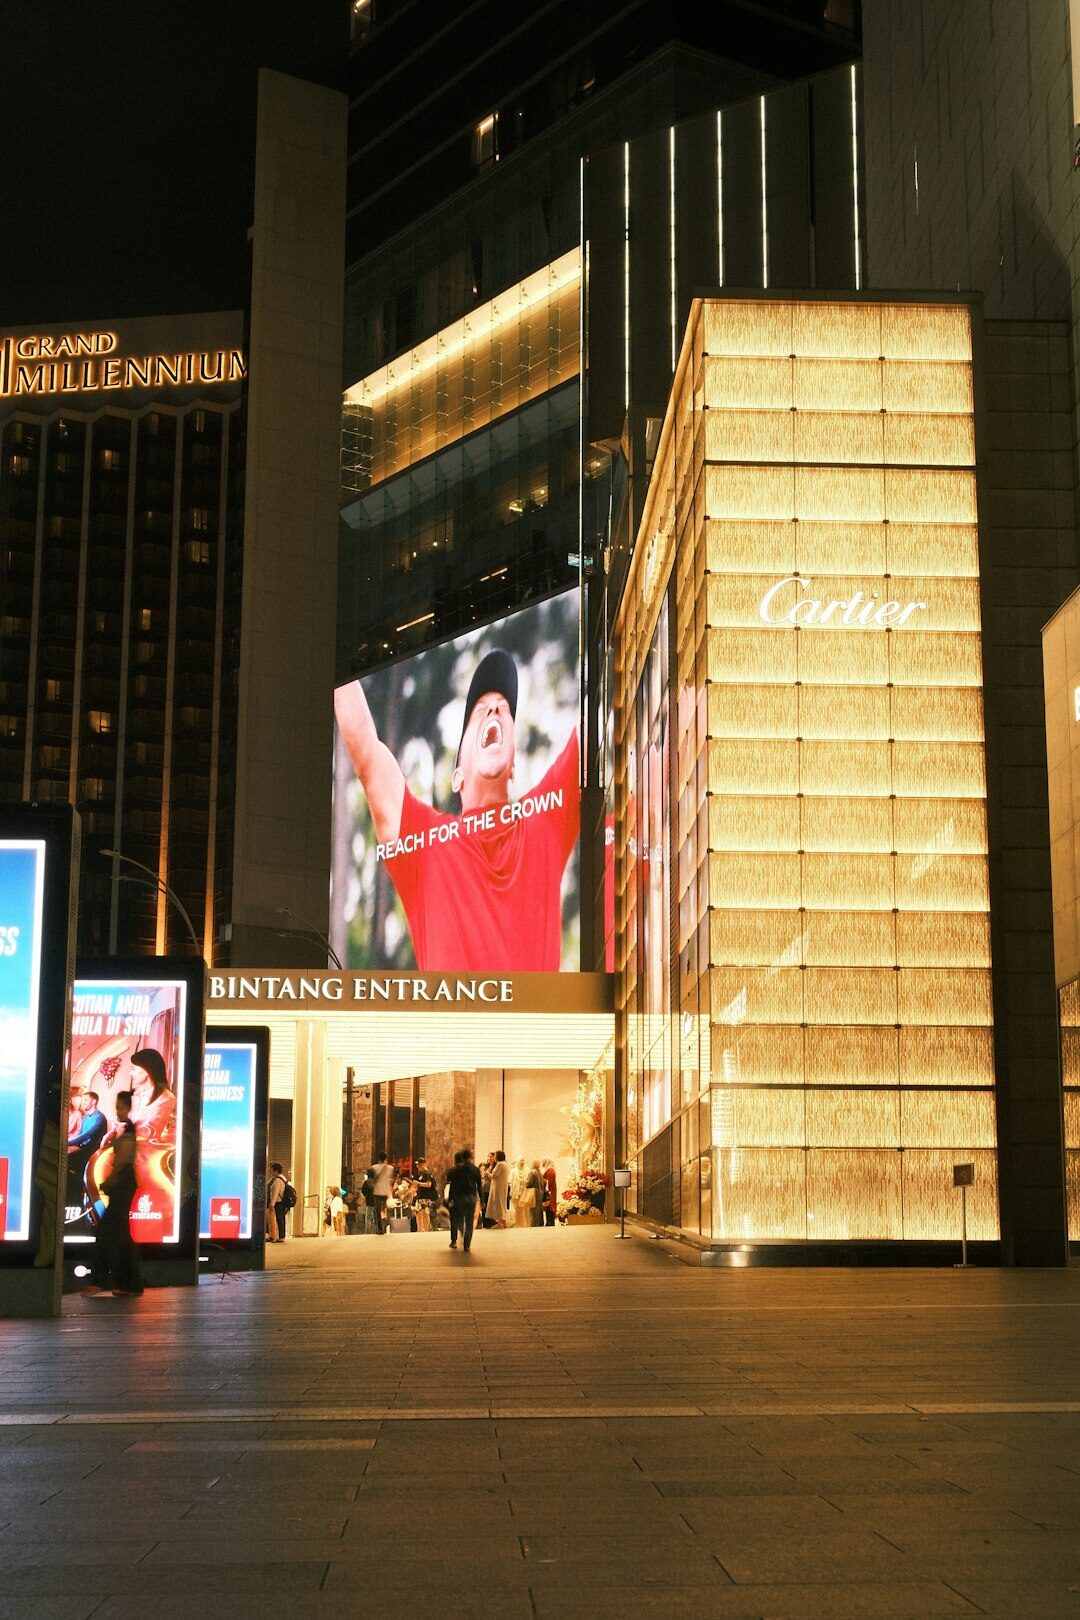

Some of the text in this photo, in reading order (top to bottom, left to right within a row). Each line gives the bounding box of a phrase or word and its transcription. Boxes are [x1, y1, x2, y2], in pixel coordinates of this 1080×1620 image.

[16, 332, 116, 358] GRAND
[759, 577, 927, 626] Cartier
[375, 789, 563, 861] REACH FOR THE CROWN
[209, 976, 514, 1002] BINTANG ENTRANCE
[114, 994, 150, 1014] ANDA
[106, 1015, 121, 1035] DI
[123, 1015, 152, 1035] SINI
[212, 1213, 239, 1222] Emirates
